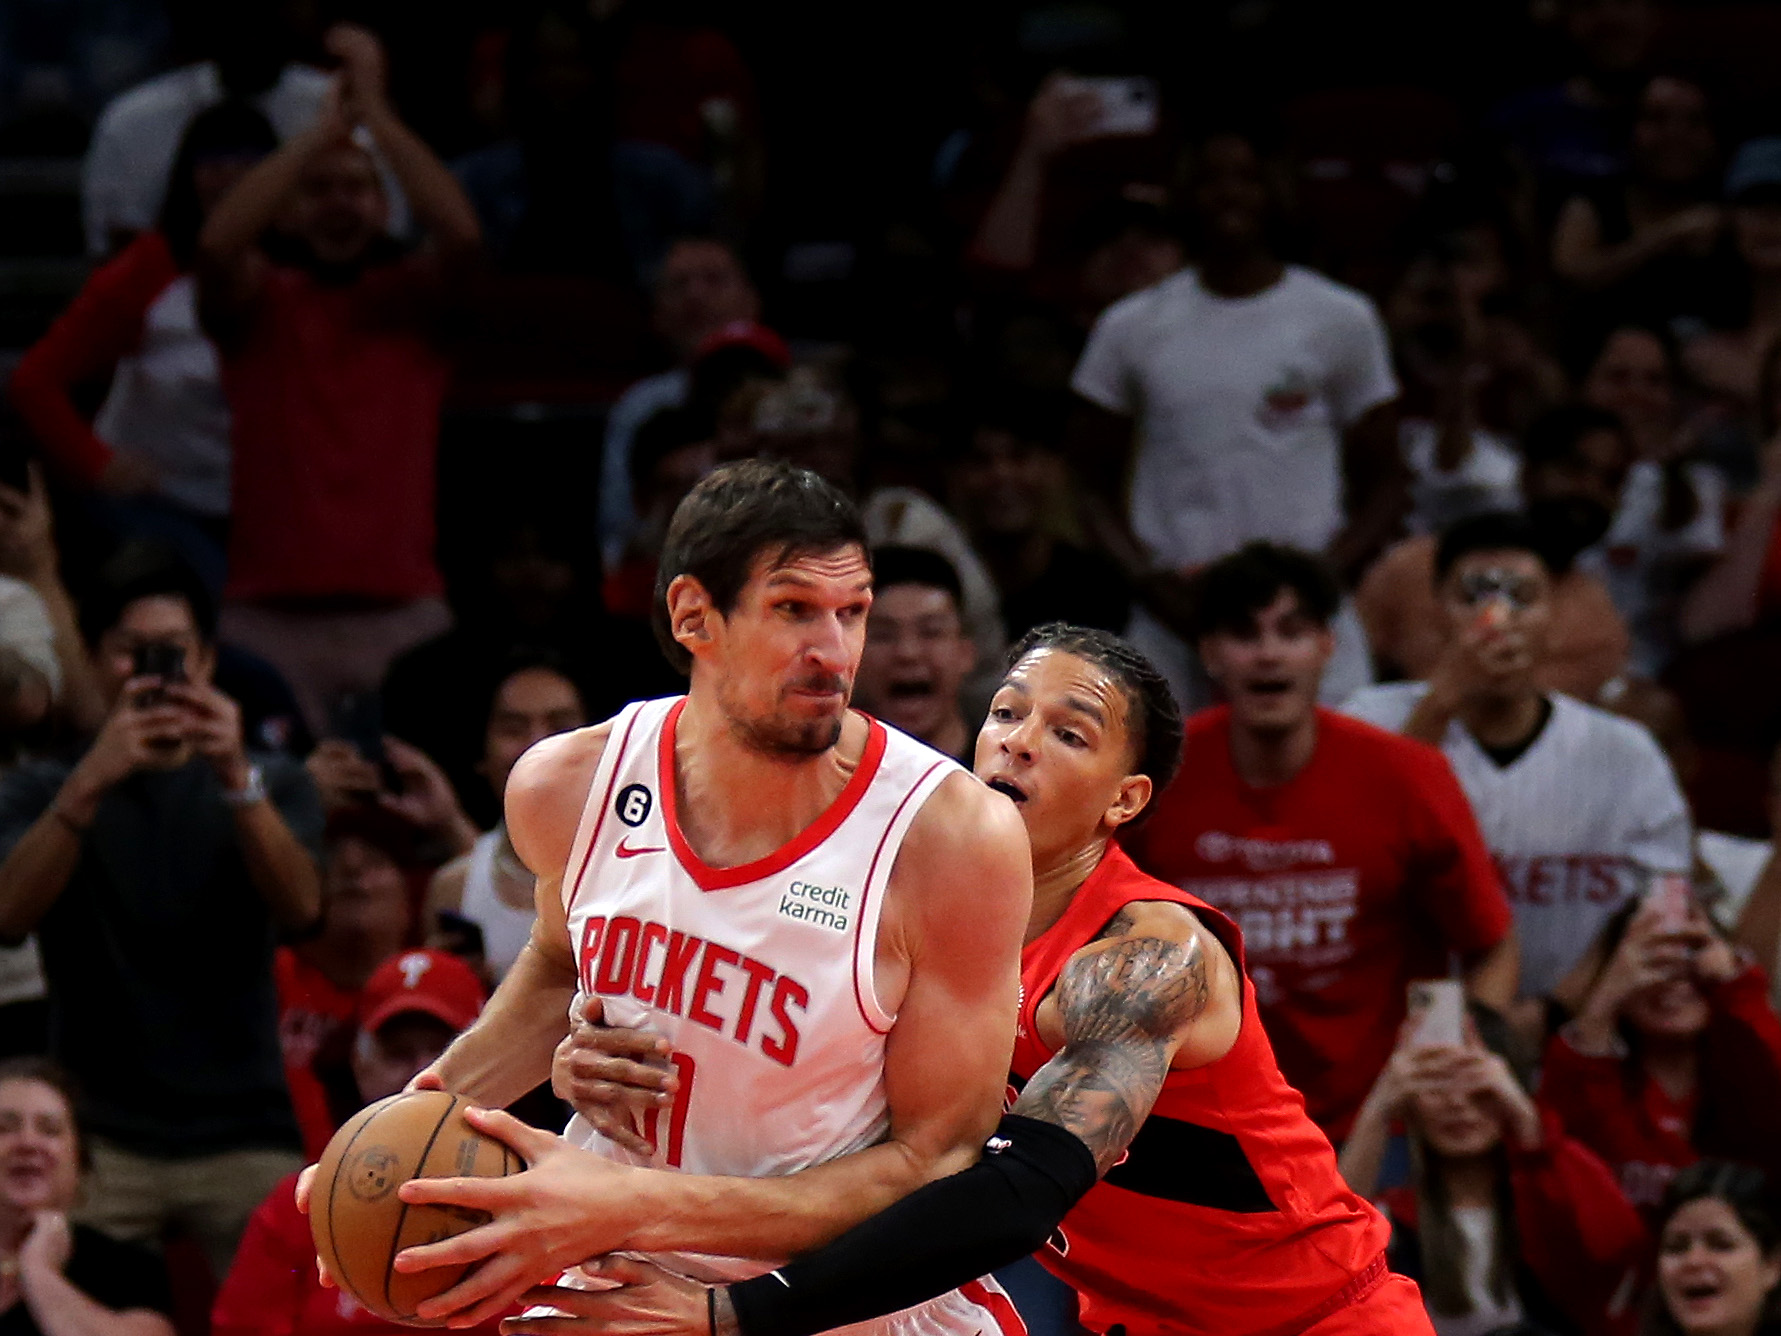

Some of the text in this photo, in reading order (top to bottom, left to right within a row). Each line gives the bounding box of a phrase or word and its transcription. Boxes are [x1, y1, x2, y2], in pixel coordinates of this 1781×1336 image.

[623, 789, 648, 823] 6
[789, 881, 851, 910] credit
[1493, 853, 1624, 906] KETS
[779, 894, 848, 931] karma
[580, 915, 810, 1068] ROCKETS
